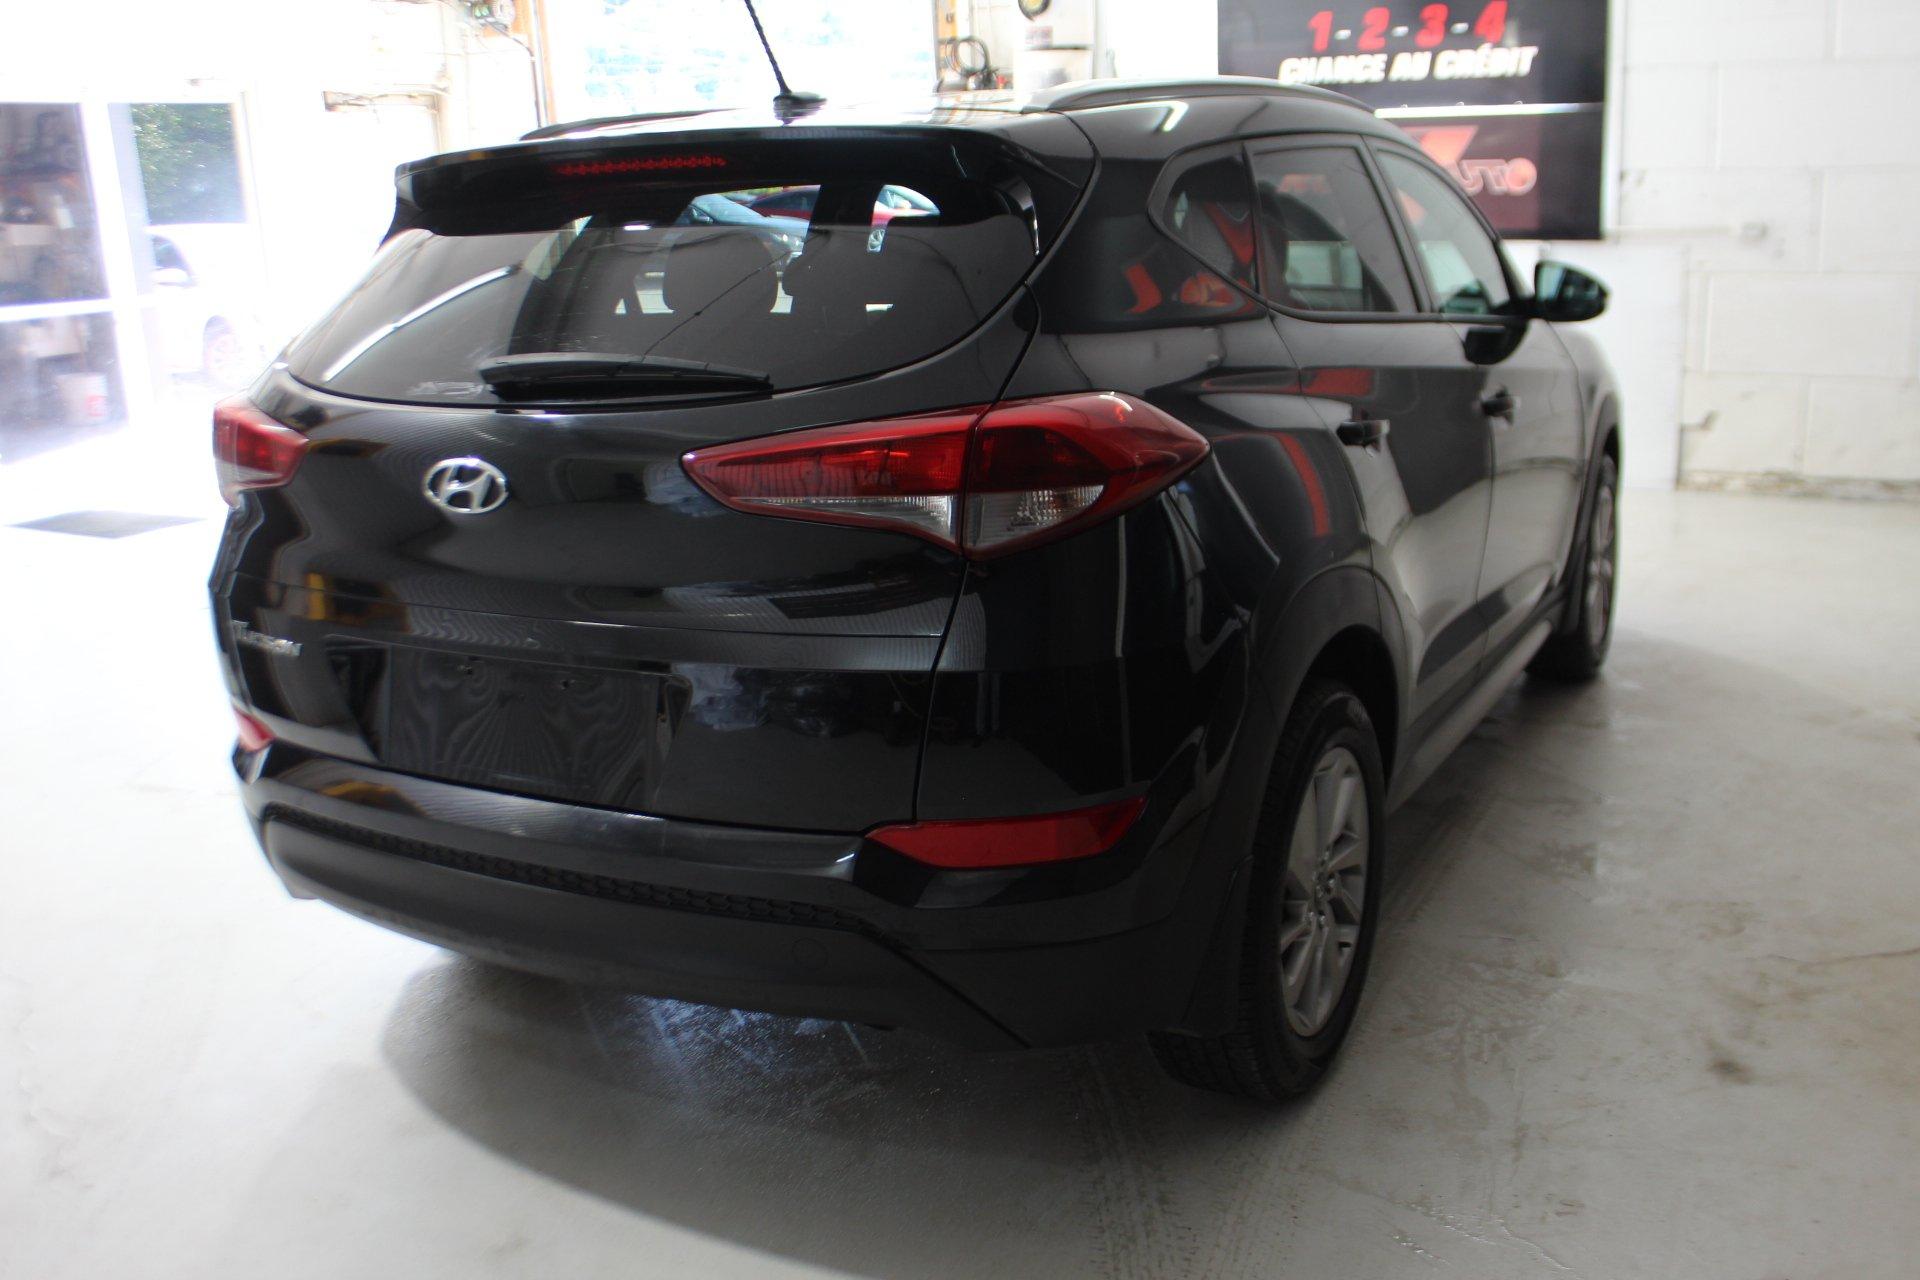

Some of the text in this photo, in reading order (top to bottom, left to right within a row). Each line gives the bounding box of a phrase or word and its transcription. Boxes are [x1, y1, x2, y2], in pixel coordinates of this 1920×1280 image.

[1278, 44, 1539, 84] CHANCE AU CRÉDIT
